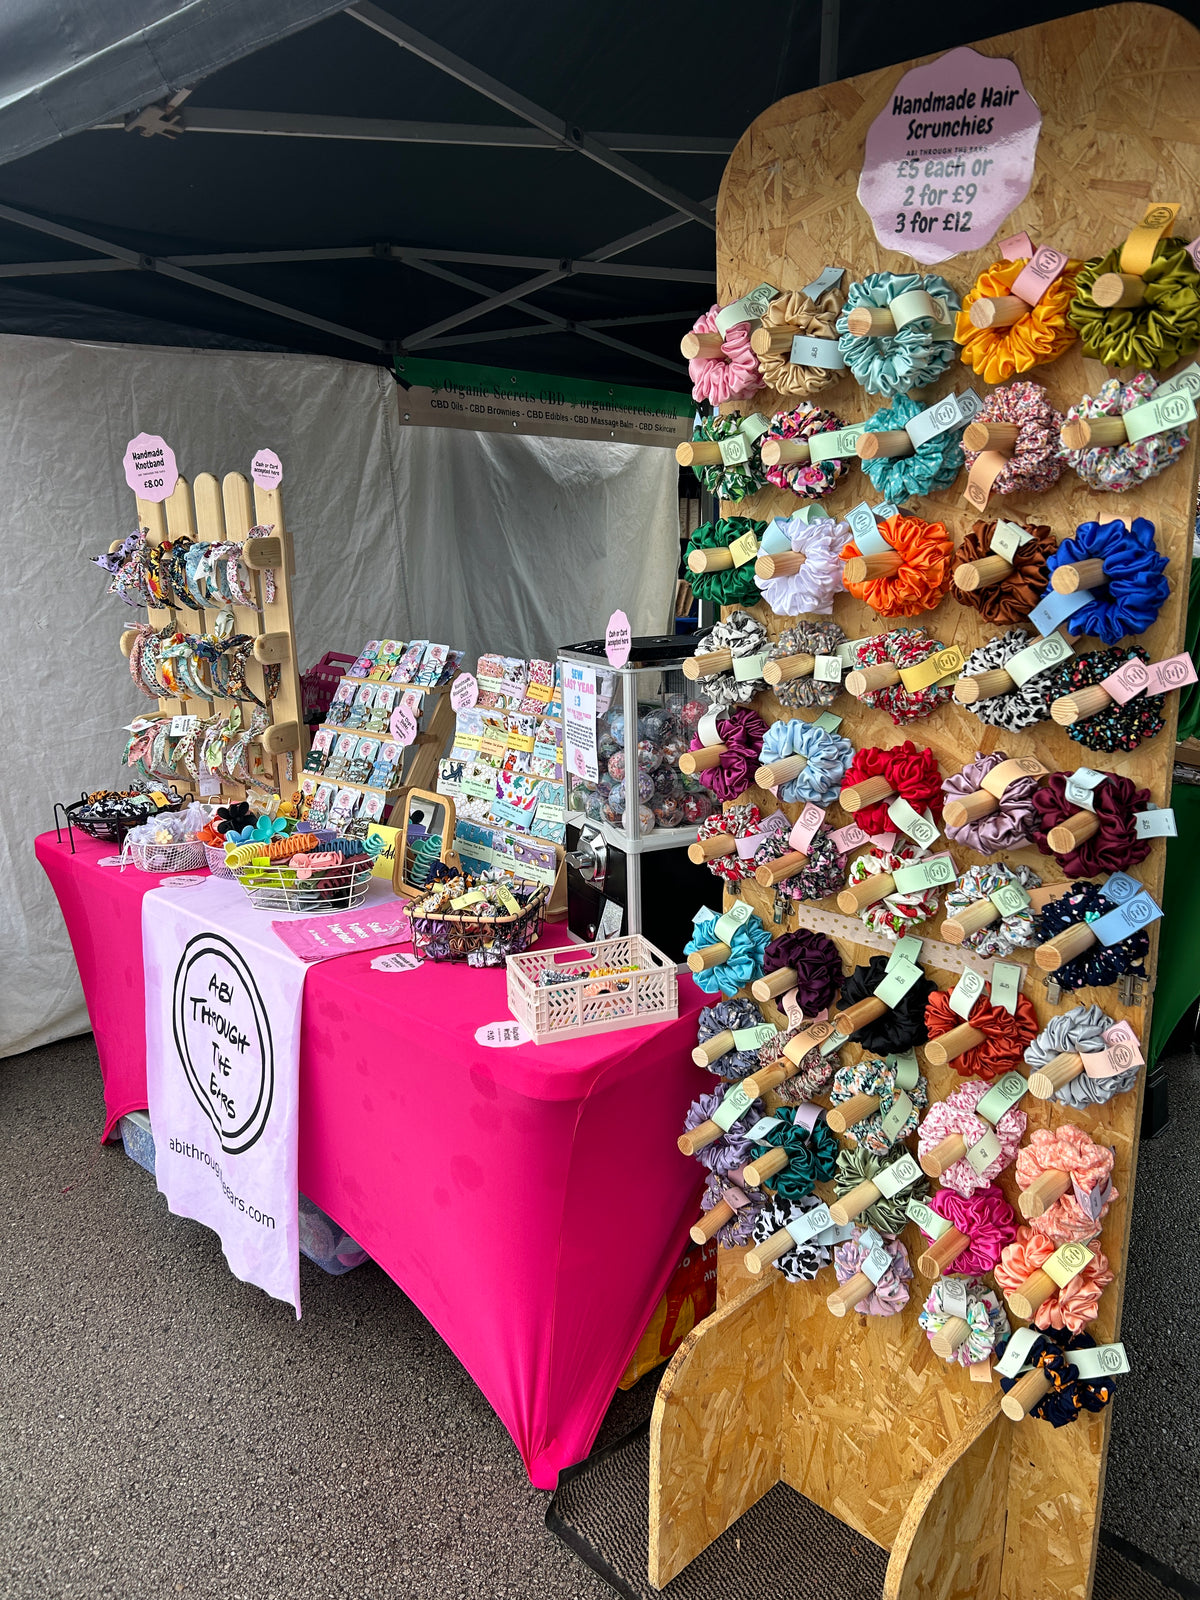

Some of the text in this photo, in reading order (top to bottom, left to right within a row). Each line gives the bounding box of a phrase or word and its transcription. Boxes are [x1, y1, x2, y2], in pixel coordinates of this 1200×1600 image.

[892, 85, 1019, 115] Handmade Hair
[906, 115, 995, 140] Scrunchies
[920, 147, 952, 156] THROUGH
[896, 155, 993, 179] £5 each or
[903, 183, 978, 207] 2 for £9
[894, 210, 973, 233] 3 for £12
[443, 378, 677, 420] Organic Secrets CBD organicsecrets.co.uk
[430, 400, 449, 409] CBD
[451, 401, 463, 411] Oils
[470, 404, 485, 414] CBD
[487, 405, 520, 417] Brownies
[526, 410, 543, 419] CBD
[545, 411, 569, 422] Edibles
[574, 415, 589, 424] CBD
[590, 416, 619, 428] Massage
[620, 420, 633, 429] Balm
[639, 422, 653, 431] CBD
[654, 424, 676, 434] Skincare
[132, 448, 163, 460] Handmade
[135, 458, 164, 470] Knotband
[144, 478, 164, 488] £8.00
[564, 677, 577, 690] LAST
[577, 681, 594, 695] YEAR
[571, 668, 583, 680] SEW
[208, 973, 234, 1006] ABI
[190, 997, 250, 1054] THROUGH
[212, 1041, 232, 1076] THE
[210, 1072, 236, 1119] EARS
[704, 1269, 718, 1282] an
